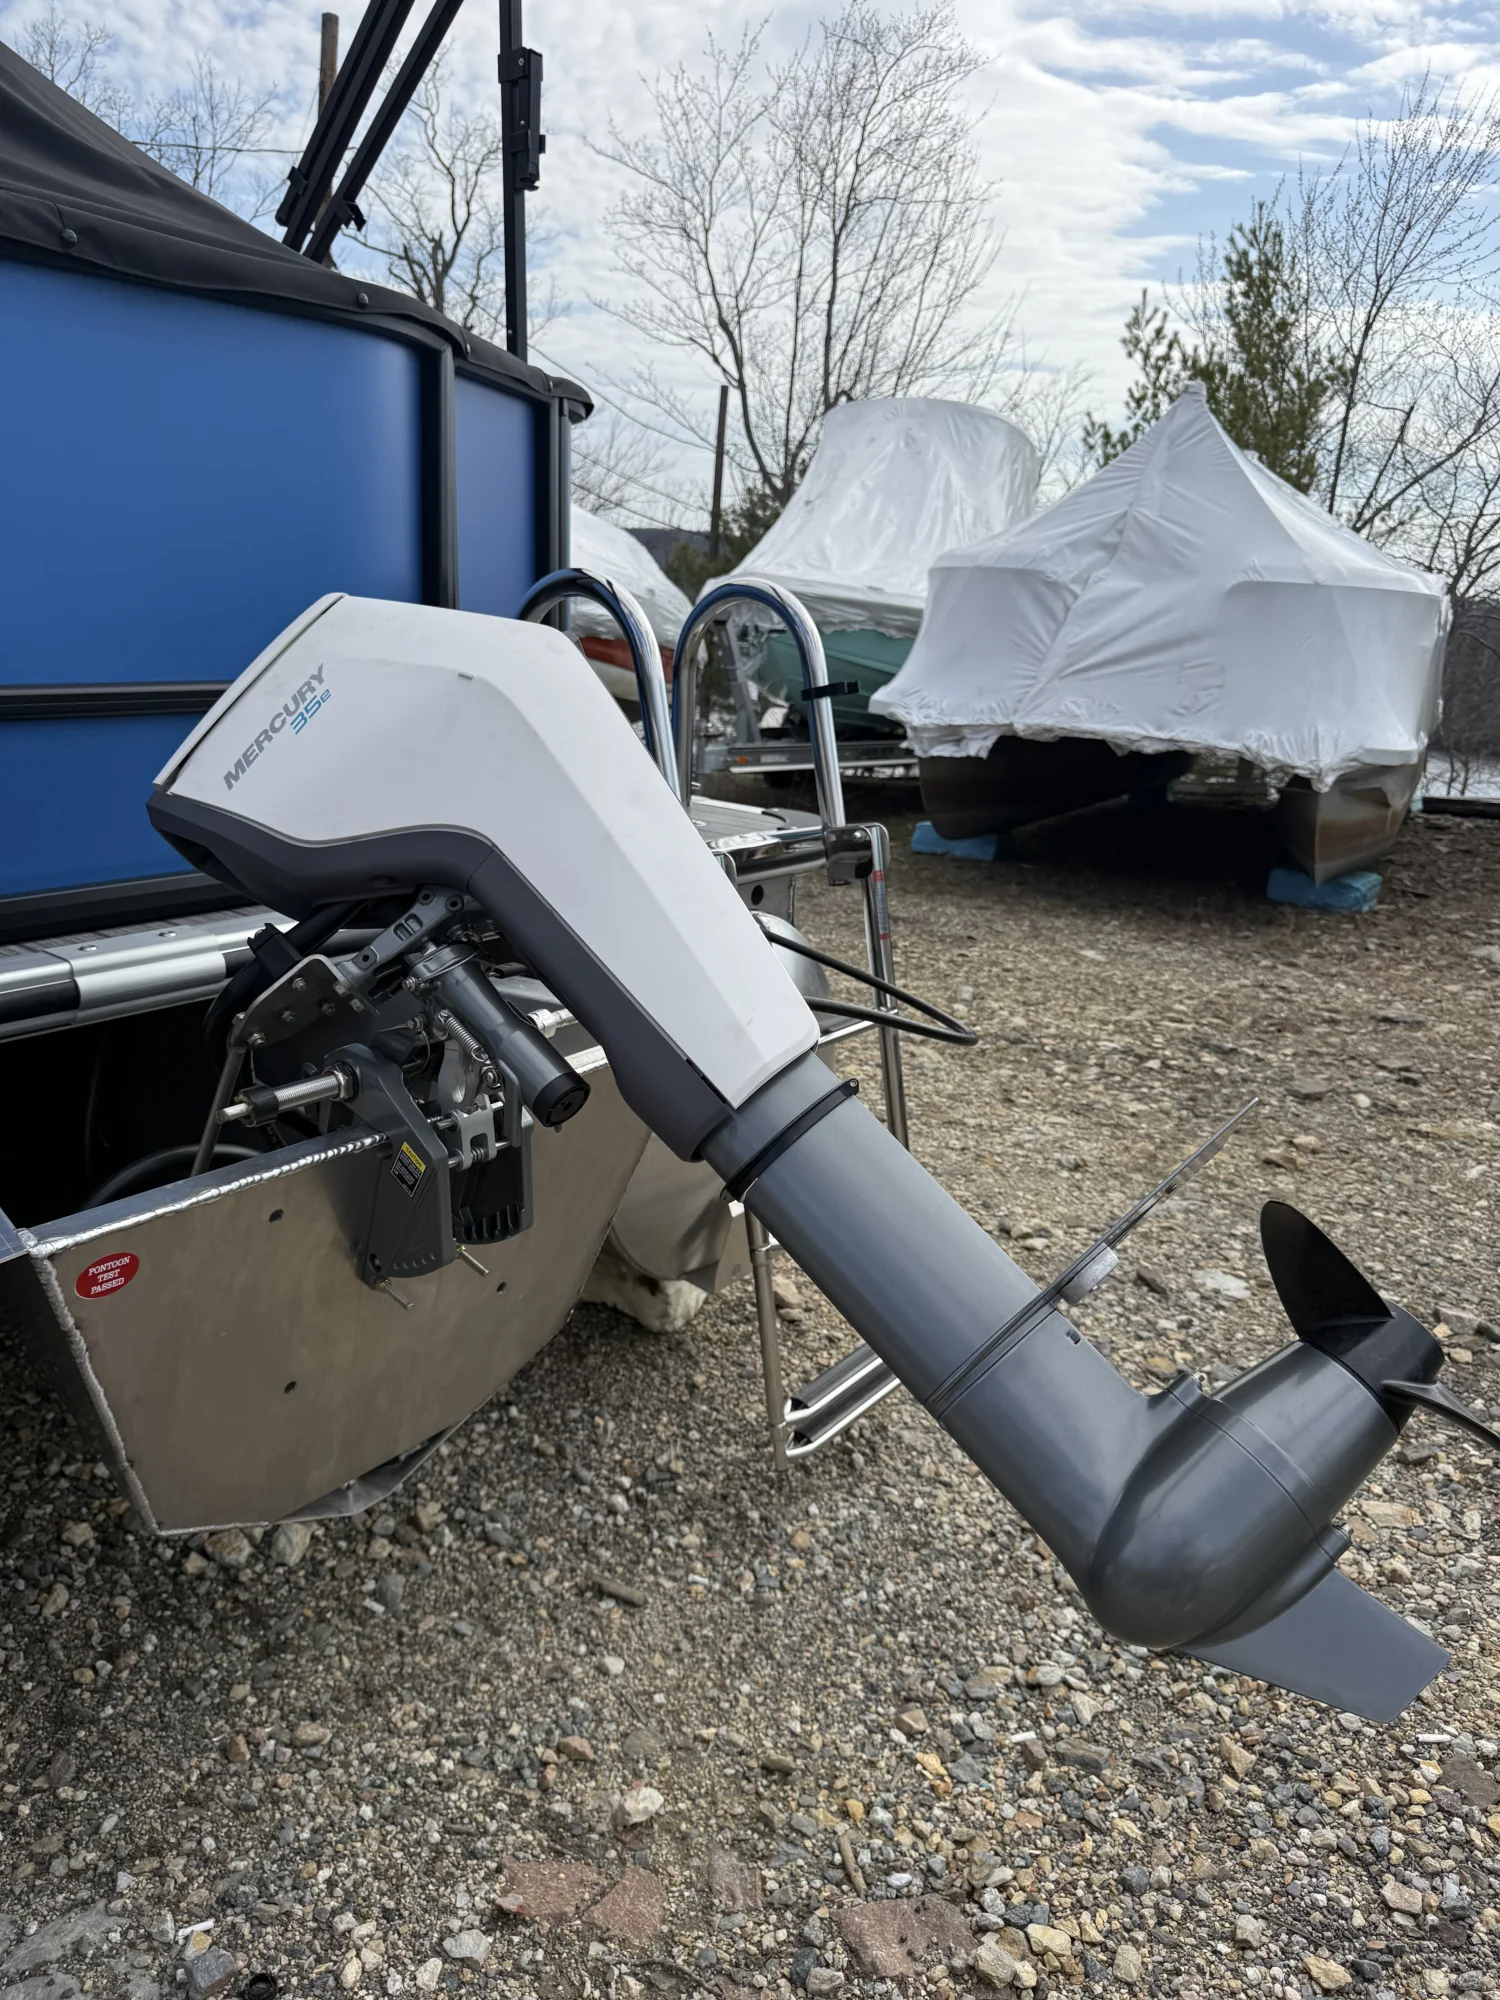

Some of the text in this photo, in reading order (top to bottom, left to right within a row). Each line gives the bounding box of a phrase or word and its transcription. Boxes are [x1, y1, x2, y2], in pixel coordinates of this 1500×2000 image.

[290, 688, 331, 735] 35e
[223, 662, 324, 791] MERCURY
[405, 1146, 424, 1169] CAUTION
[88, 1256, 131, 1276] PONTOON
[97, 1269, 120, 1282] TEST
[90, 1277, 125, 1295] PASSED
